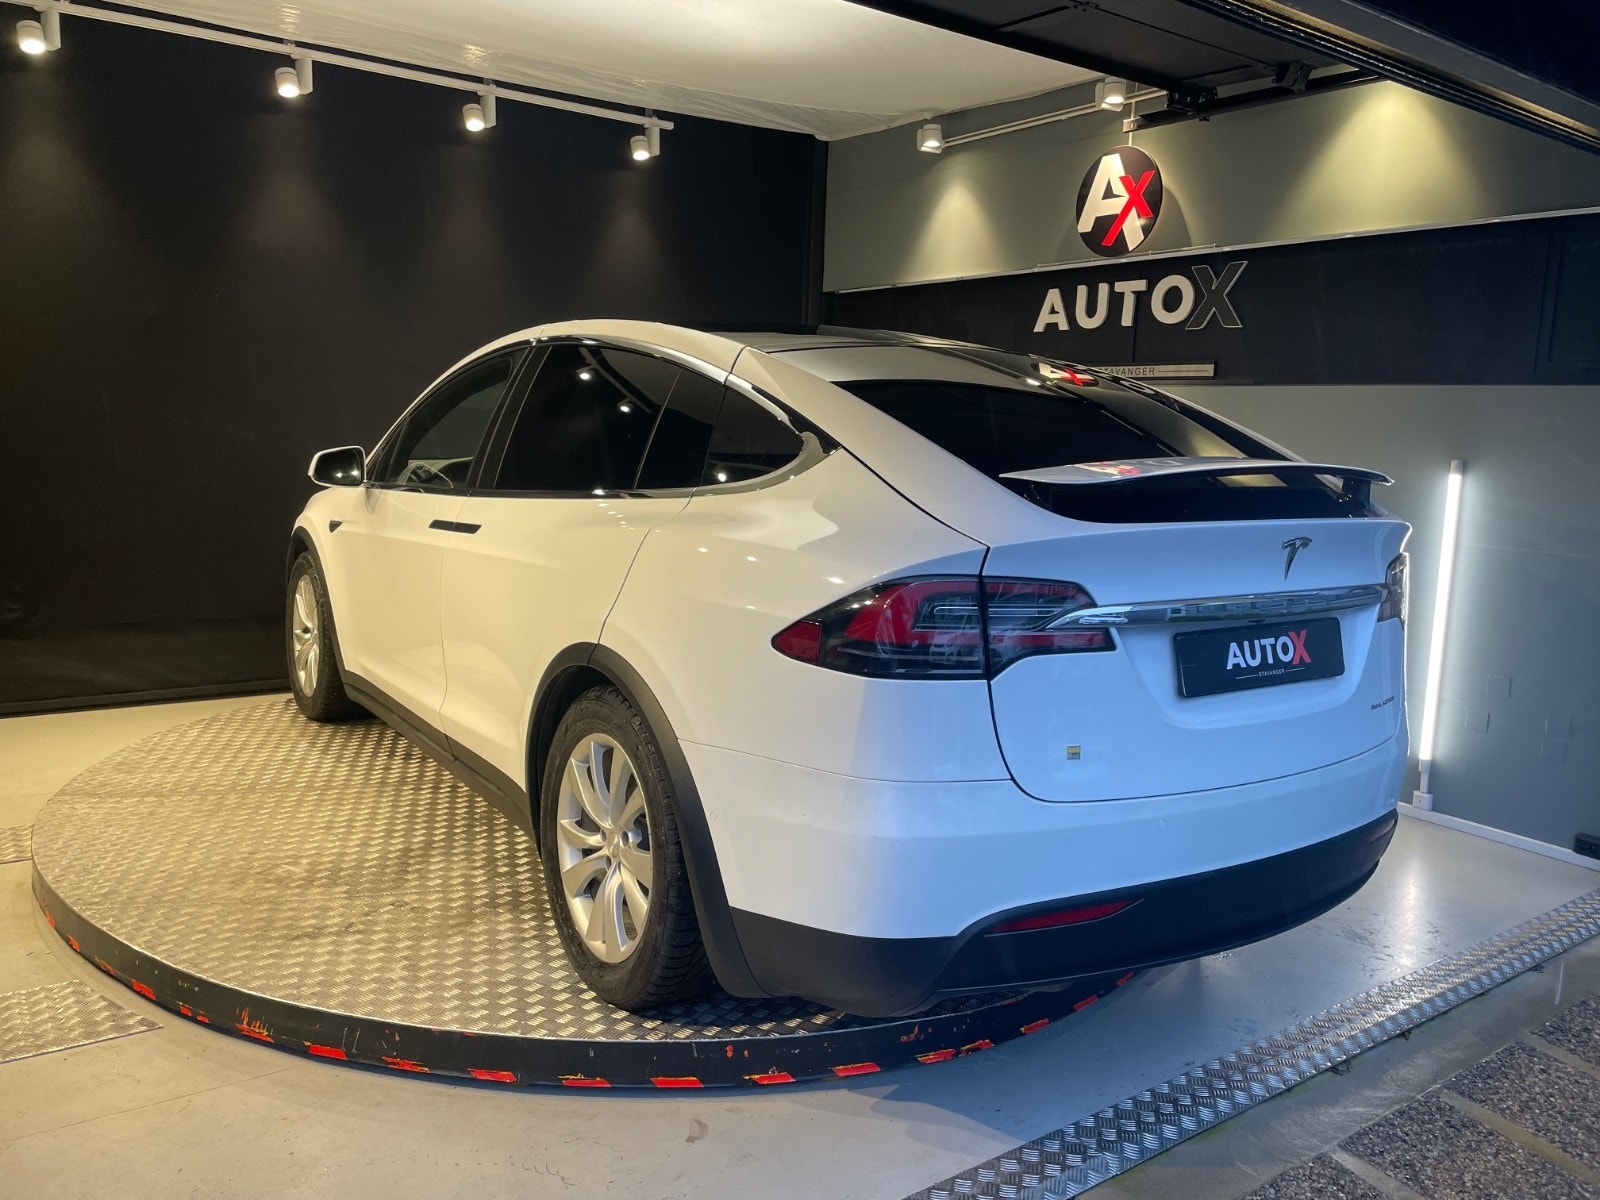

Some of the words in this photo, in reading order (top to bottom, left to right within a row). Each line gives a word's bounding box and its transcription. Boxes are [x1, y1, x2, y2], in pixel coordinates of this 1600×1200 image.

[1033, 261, 1248, 332] AUTOX
[1099, 367, 1155, 376] TAVANGER
[1226, 629, 1312, 670] AUTOX
